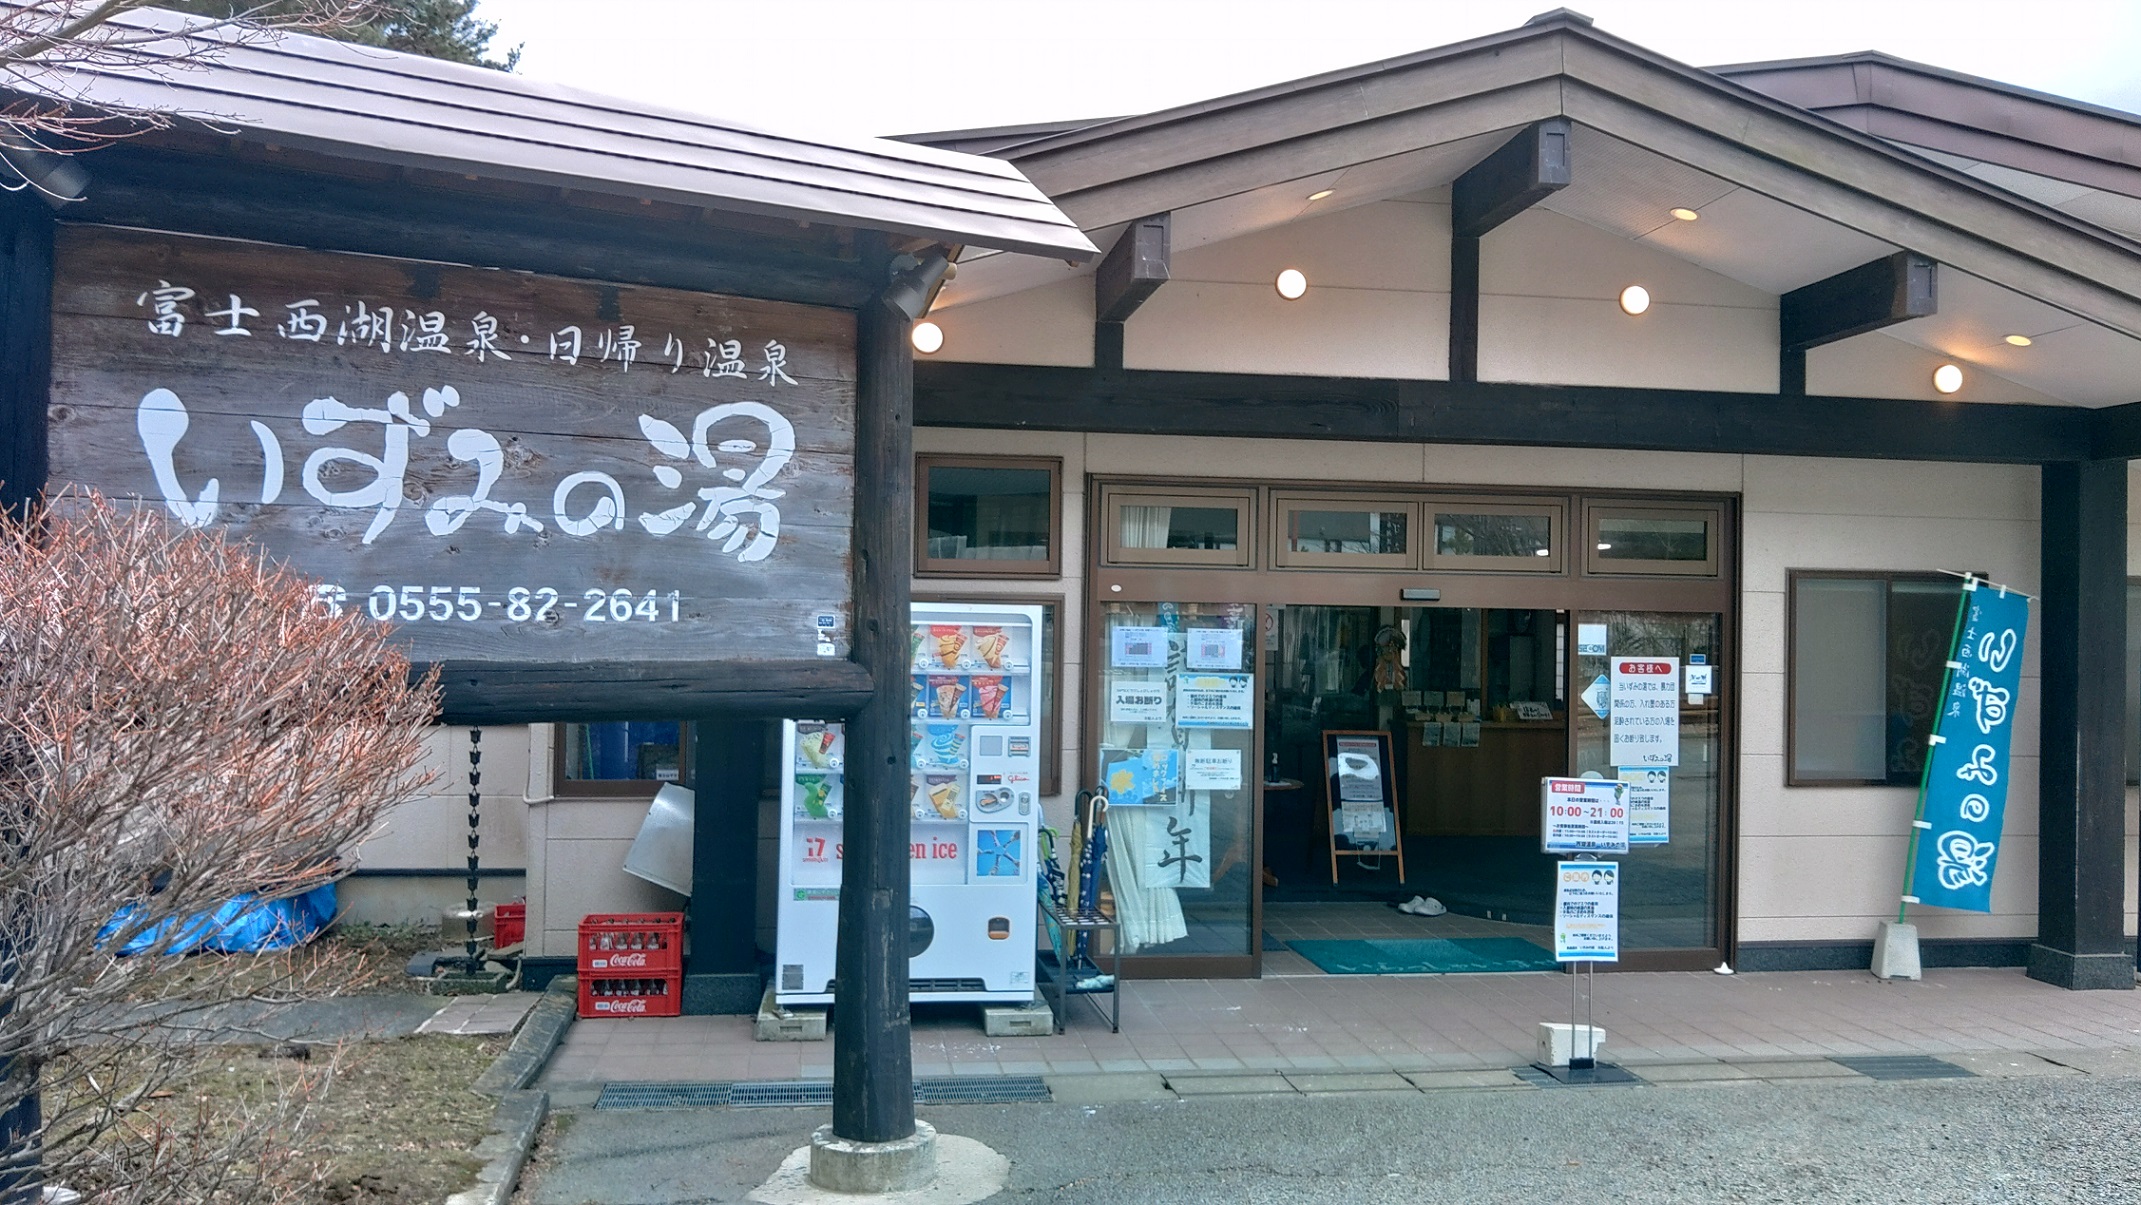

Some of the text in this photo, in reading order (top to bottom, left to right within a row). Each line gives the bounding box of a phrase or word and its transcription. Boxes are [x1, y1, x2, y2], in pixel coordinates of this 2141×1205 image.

[137, 280, 799, 387] 富士西湖温泉・日帰り温泉
[138, 386, 797, 563] いずみの湯
[368, 584, 681, 622] 0555-82-2641
[1628, 664, 1663, 673] お客様へ
[1555, 783, 1582, 793] 営業時間
[932, 836, 958, 859] ice
